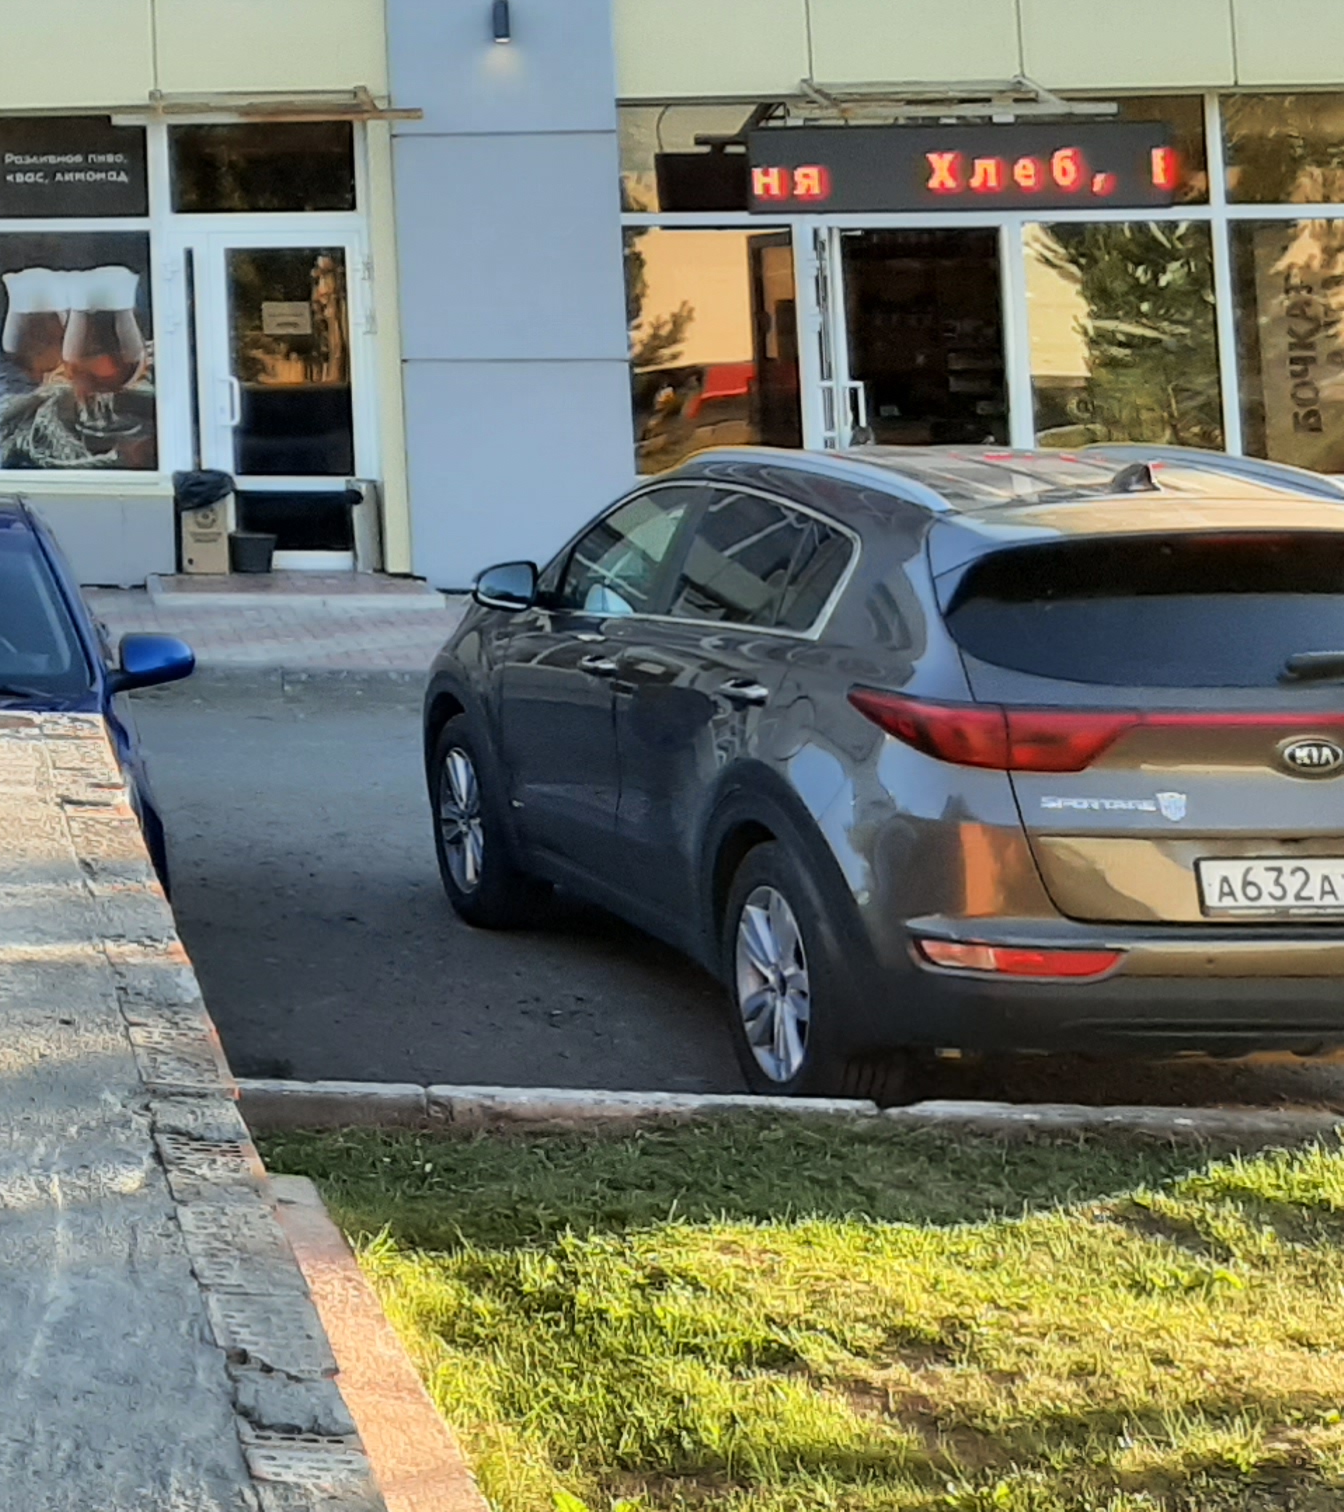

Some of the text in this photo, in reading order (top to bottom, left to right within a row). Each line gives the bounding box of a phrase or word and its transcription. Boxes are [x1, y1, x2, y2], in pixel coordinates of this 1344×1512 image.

[4, 153, 83, 165] Разливное
[924, 147, 1114, 197] Хлеб,
[1294, 745, 1335, 766] KIA
[1217, 865, 1344, 904] А632А
